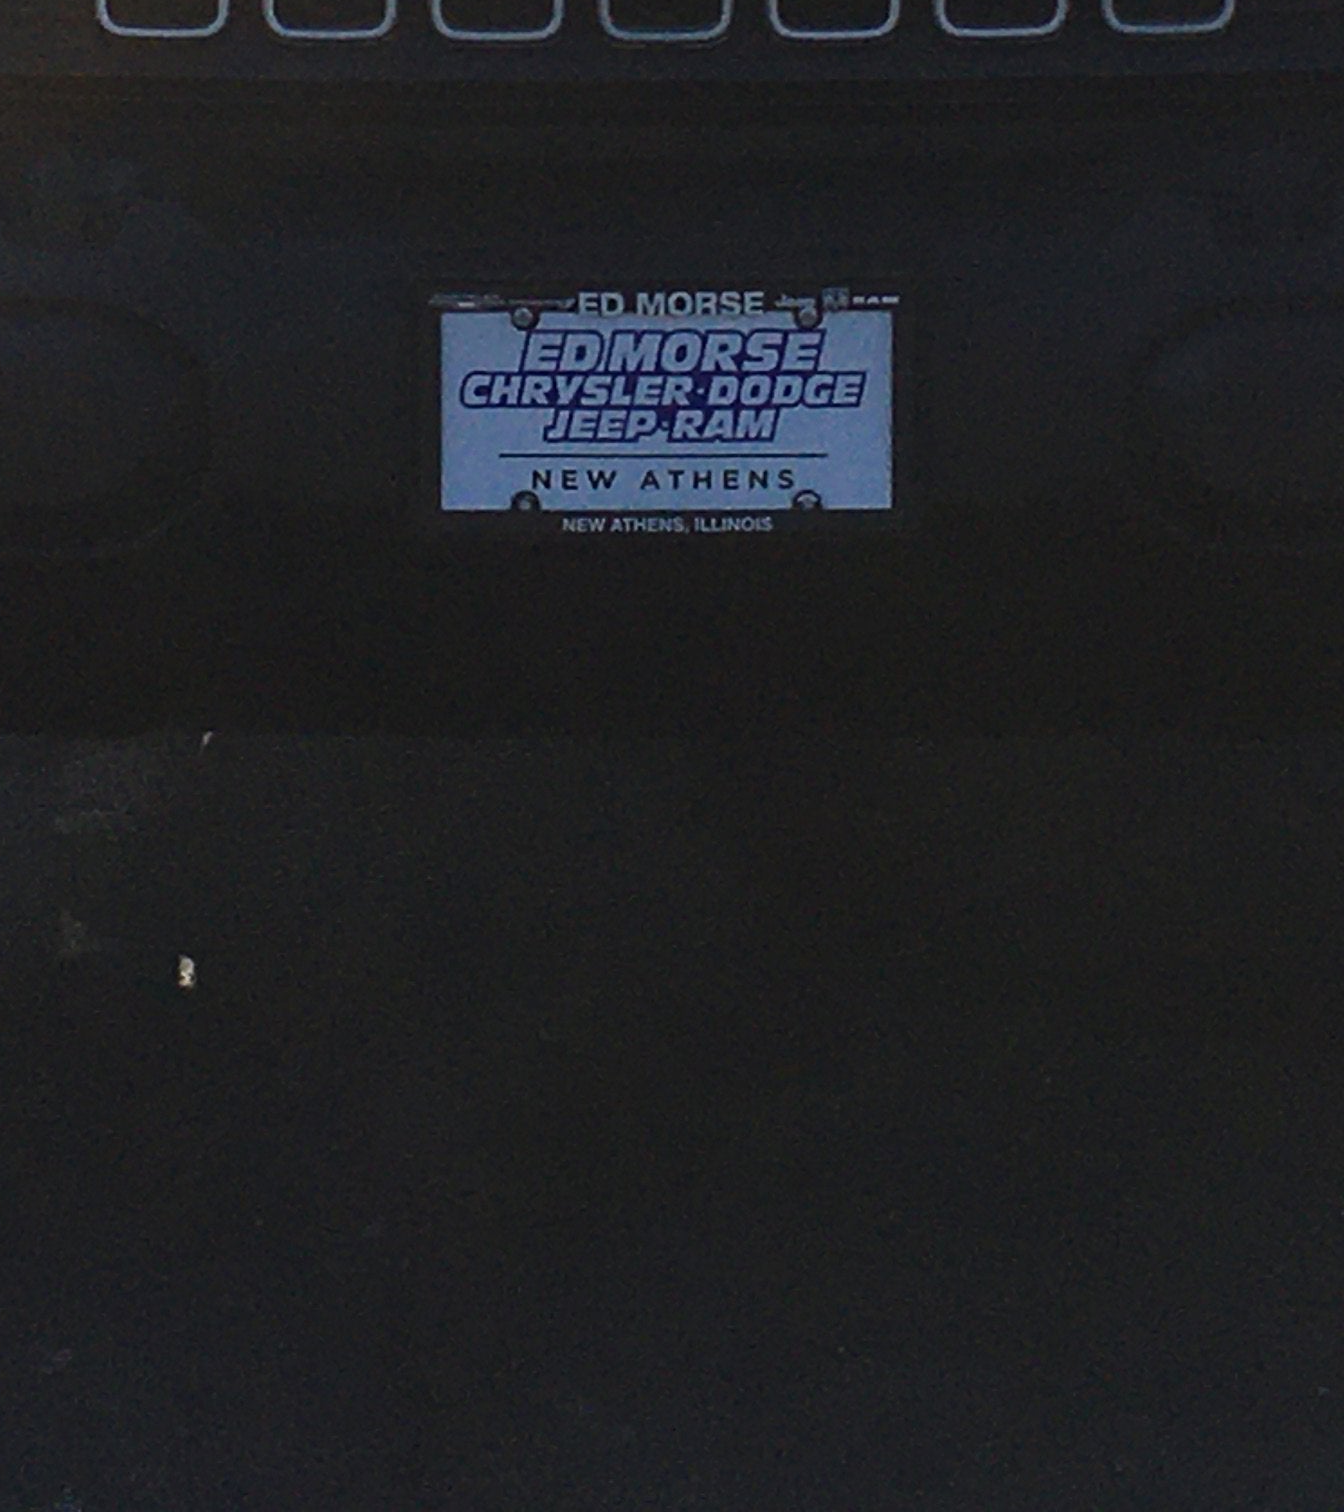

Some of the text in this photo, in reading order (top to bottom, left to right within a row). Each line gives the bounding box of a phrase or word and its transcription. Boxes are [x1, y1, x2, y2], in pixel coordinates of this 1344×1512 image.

[577, 291, 625, 317] ED
[636, 291, 764, 317] MORSE
[521, 330, 824, 372] ED MORSE
[532, 469, 795, 490] NEW ATHENS
[562, 516, 774, 534] NEW ATHENS, ILLINOIS
